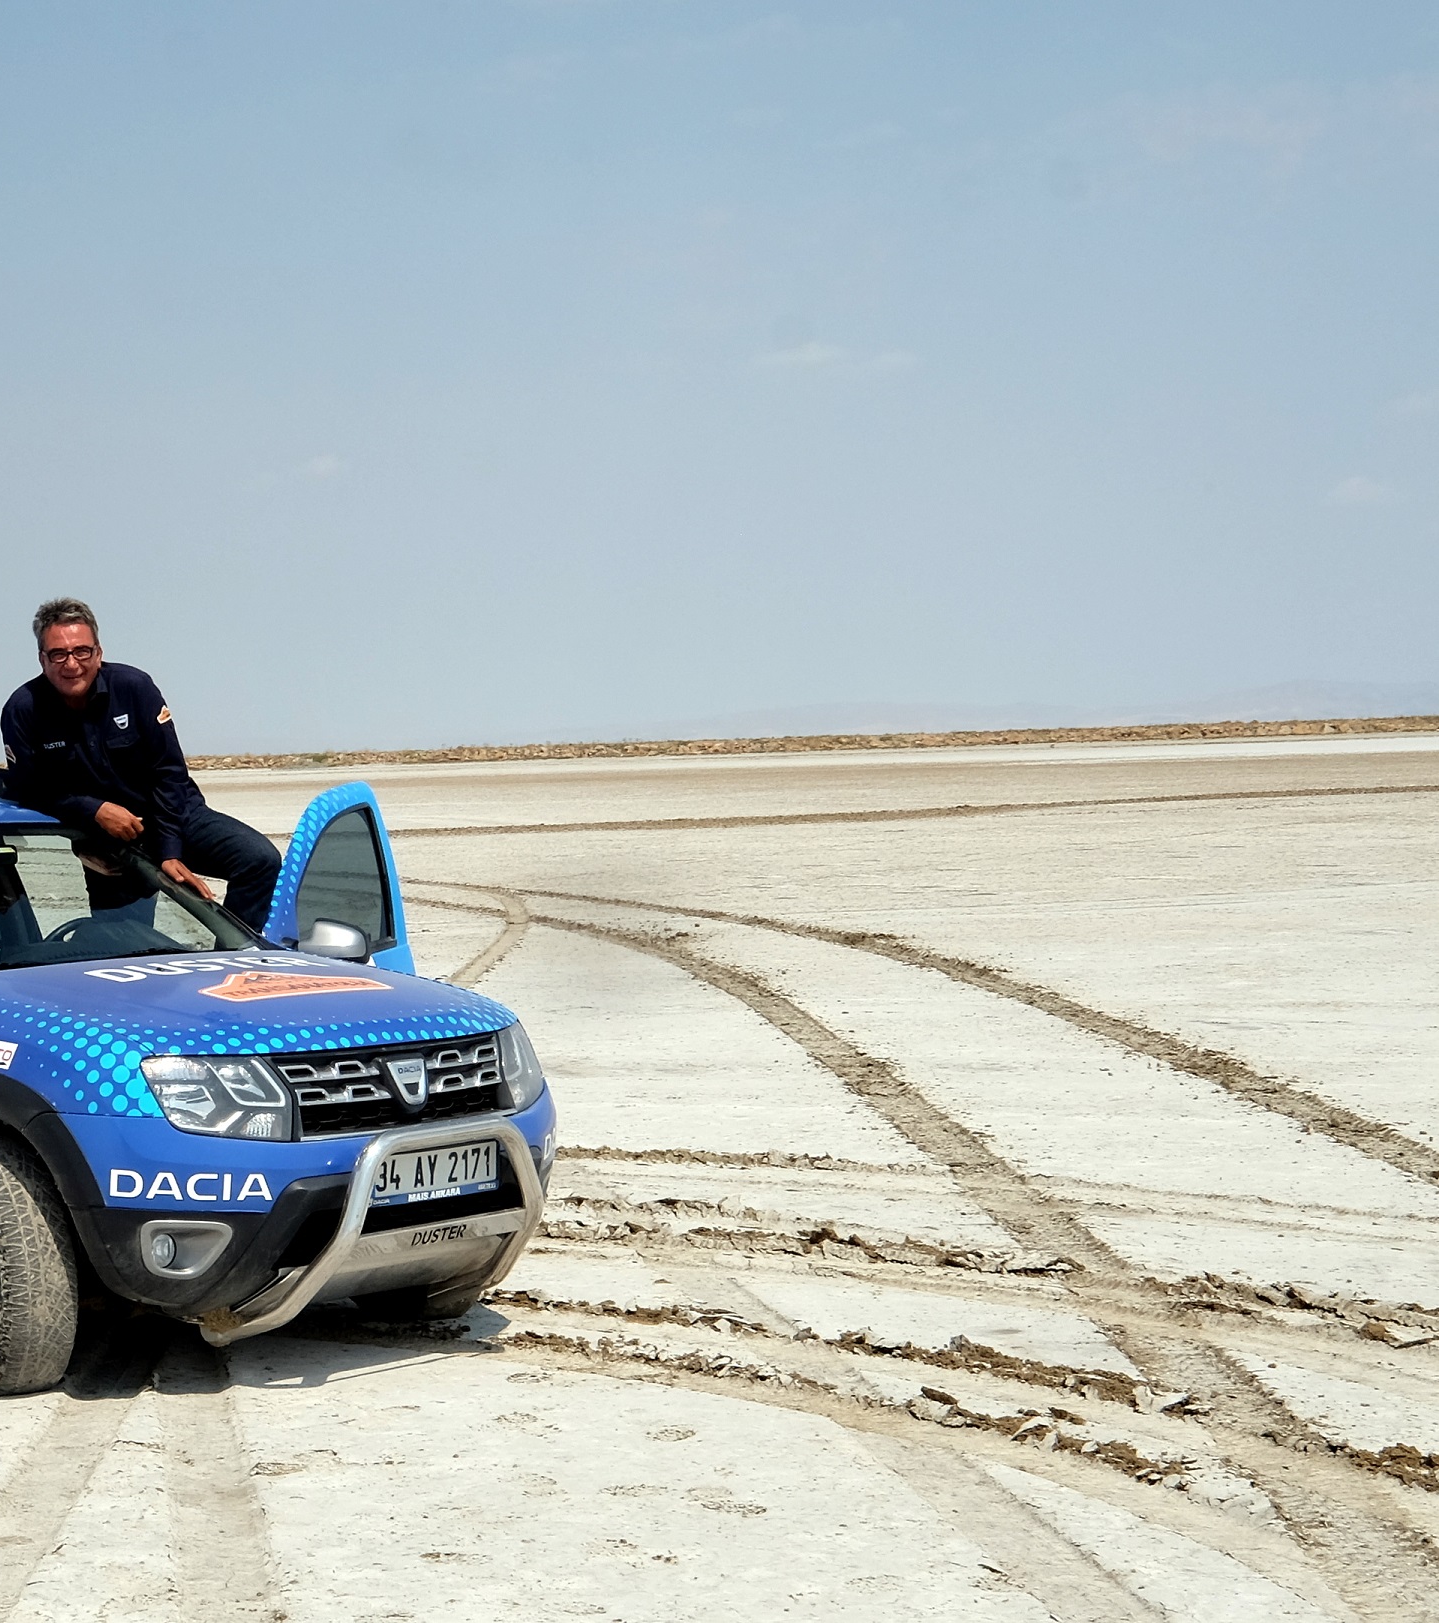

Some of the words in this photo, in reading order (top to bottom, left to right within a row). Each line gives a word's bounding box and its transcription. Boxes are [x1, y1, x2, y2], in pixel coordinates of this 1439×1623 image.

[83, 956, 331, 983] DUSTER
[397, 1064, 422, 1075] DACIA
[375, 1159, 401, 1193] 34
[413, 1154, 439, 1189] AY
[447, 1145, 492, 1184] 2171
[109, 1168, 274, 1202] DACIA
[411, 1224, 467, 1247] DUSTER
